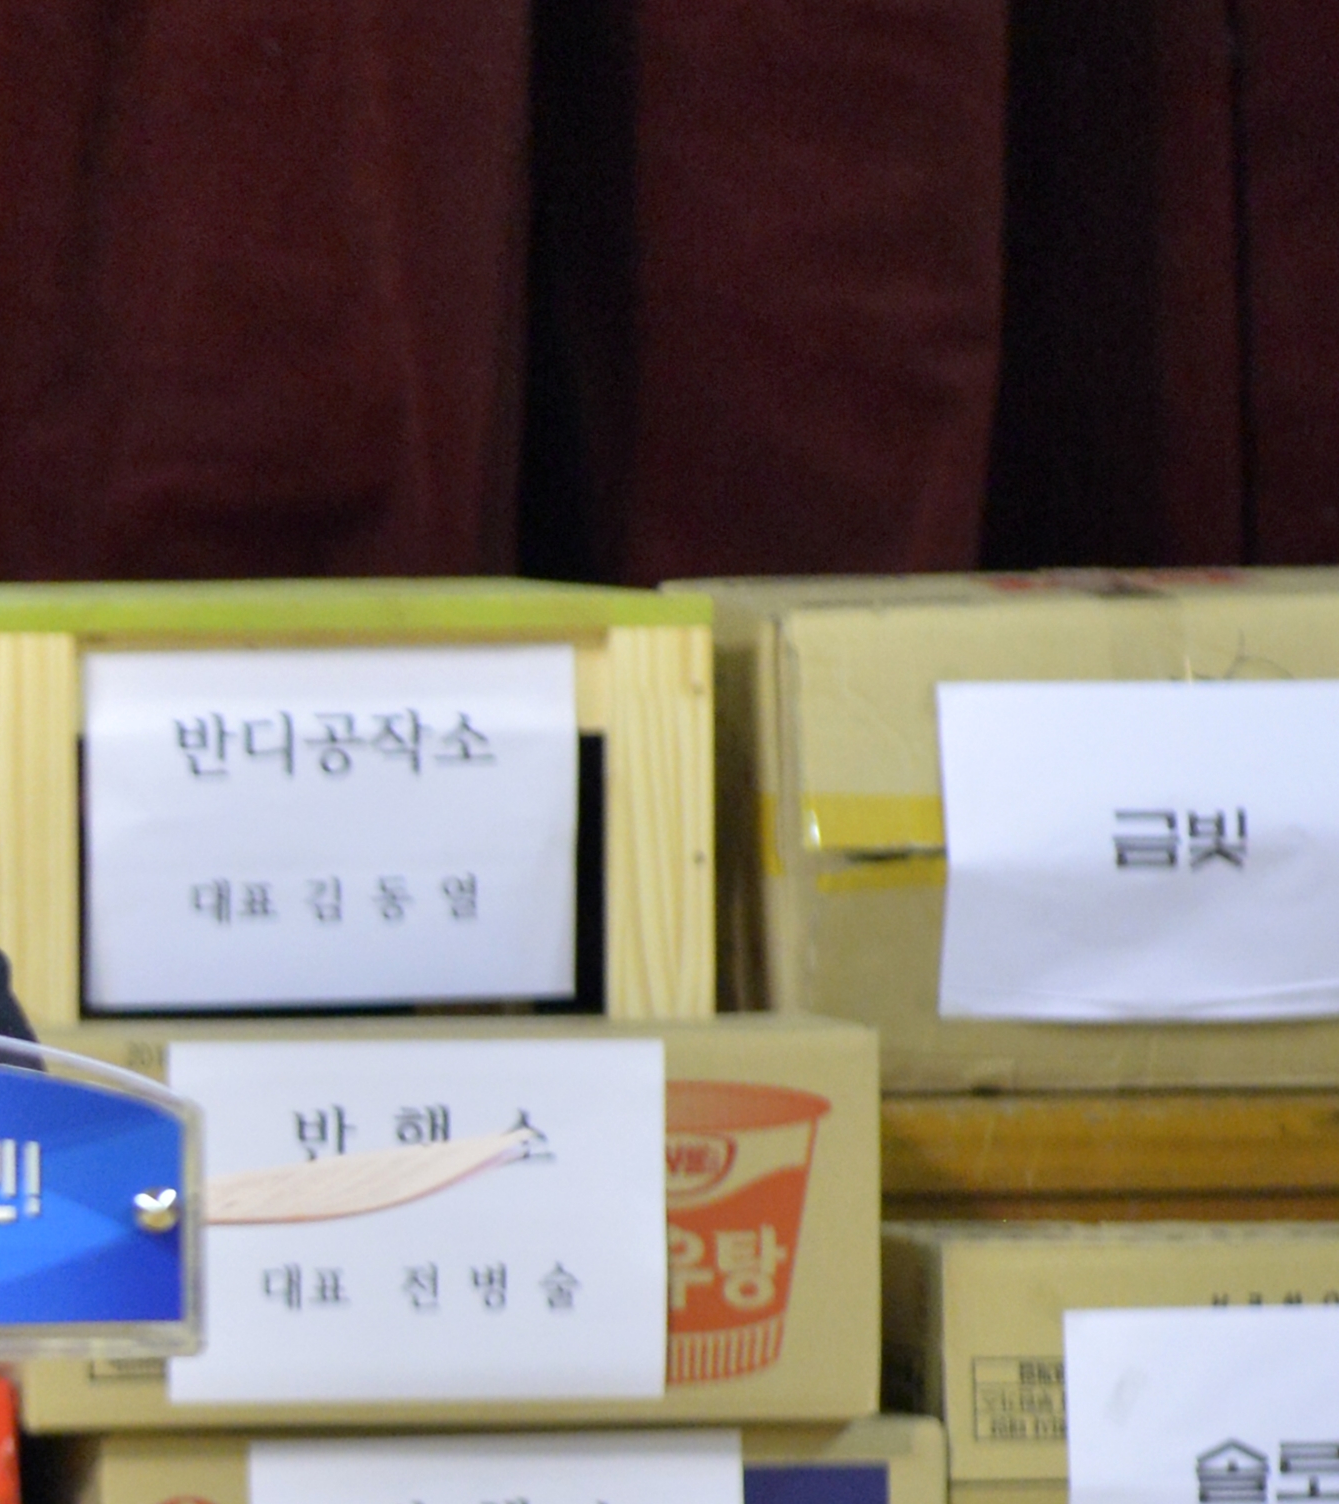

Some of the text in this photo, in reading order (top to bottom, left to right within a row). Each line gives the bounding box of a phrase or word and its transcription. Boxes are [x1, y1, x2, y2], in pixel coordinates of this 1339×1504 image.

[173, 707, 500, 785] 반디공작소
[1112, 807, 1252, 878] 금빛
[190, 877, 277, 927] 대표
[261, 1262, 348, 1312] 대표
